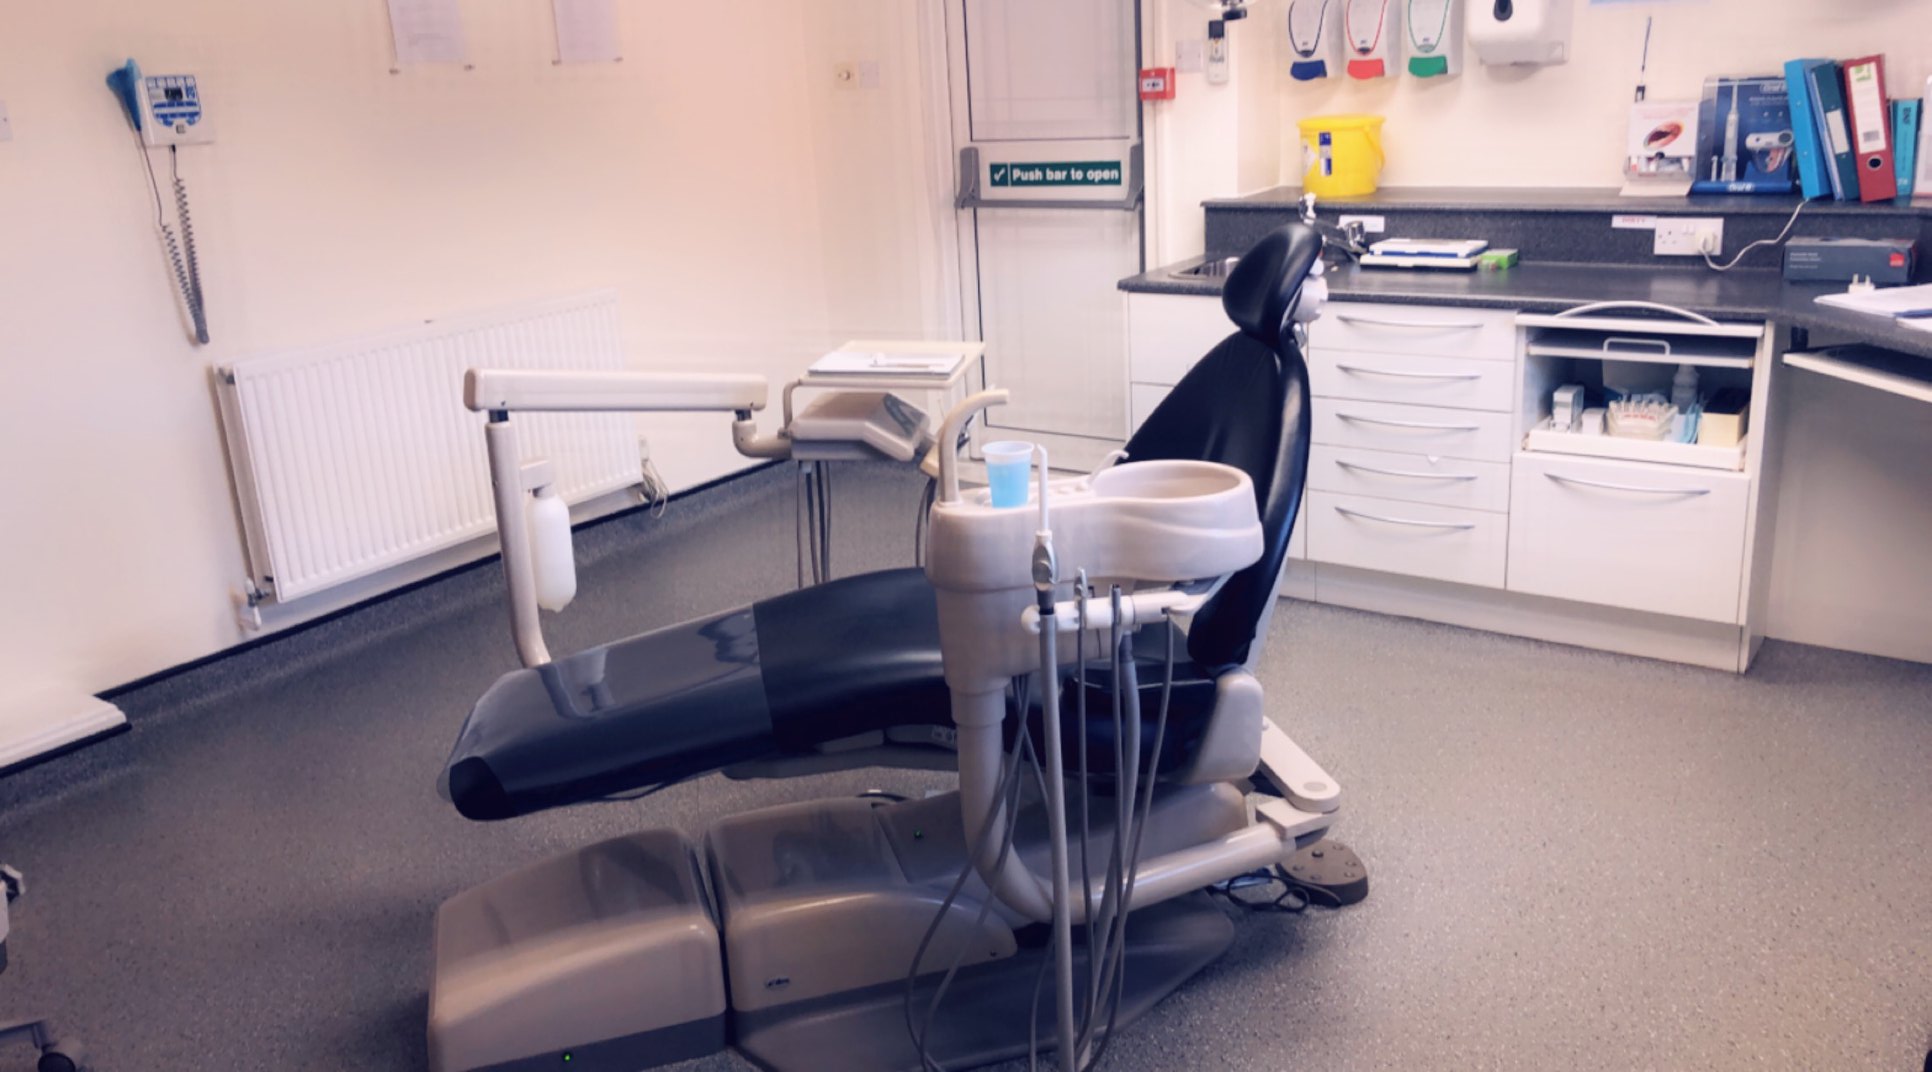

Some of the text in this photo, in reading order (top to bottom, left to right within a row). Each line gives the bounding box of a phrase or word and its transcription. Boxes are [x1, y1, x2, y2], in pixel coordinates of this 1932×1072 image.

[1012, 168, 1119, 182] Push bar to open
